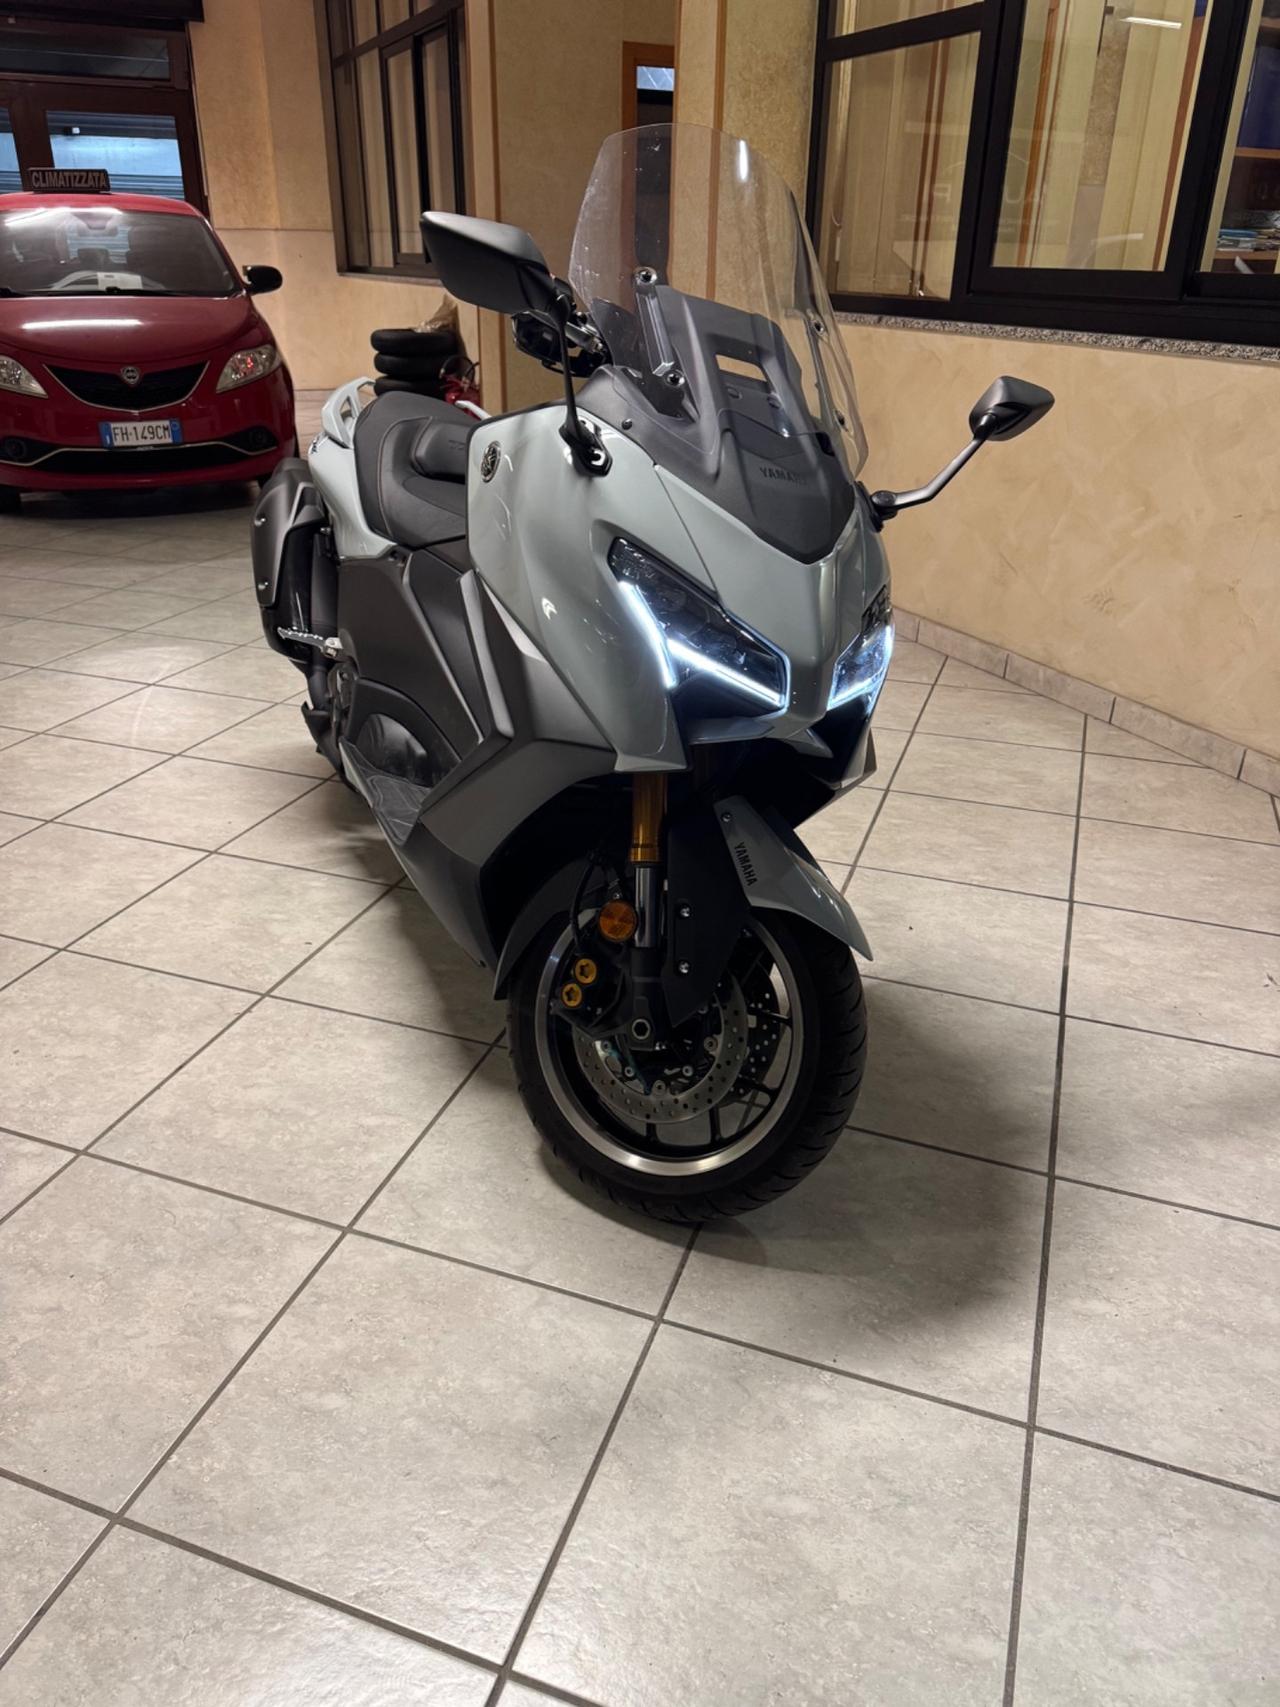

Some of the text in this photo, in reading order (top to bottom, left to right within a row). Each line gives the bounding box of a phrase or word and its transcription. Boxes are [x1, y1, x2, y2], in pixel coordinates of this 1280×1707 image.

[32, 171, 108, 188] CLIMATIZZATA
[760, 466, 807, 486] YAMA
[734, 841, 758, 887] YAMAHA
